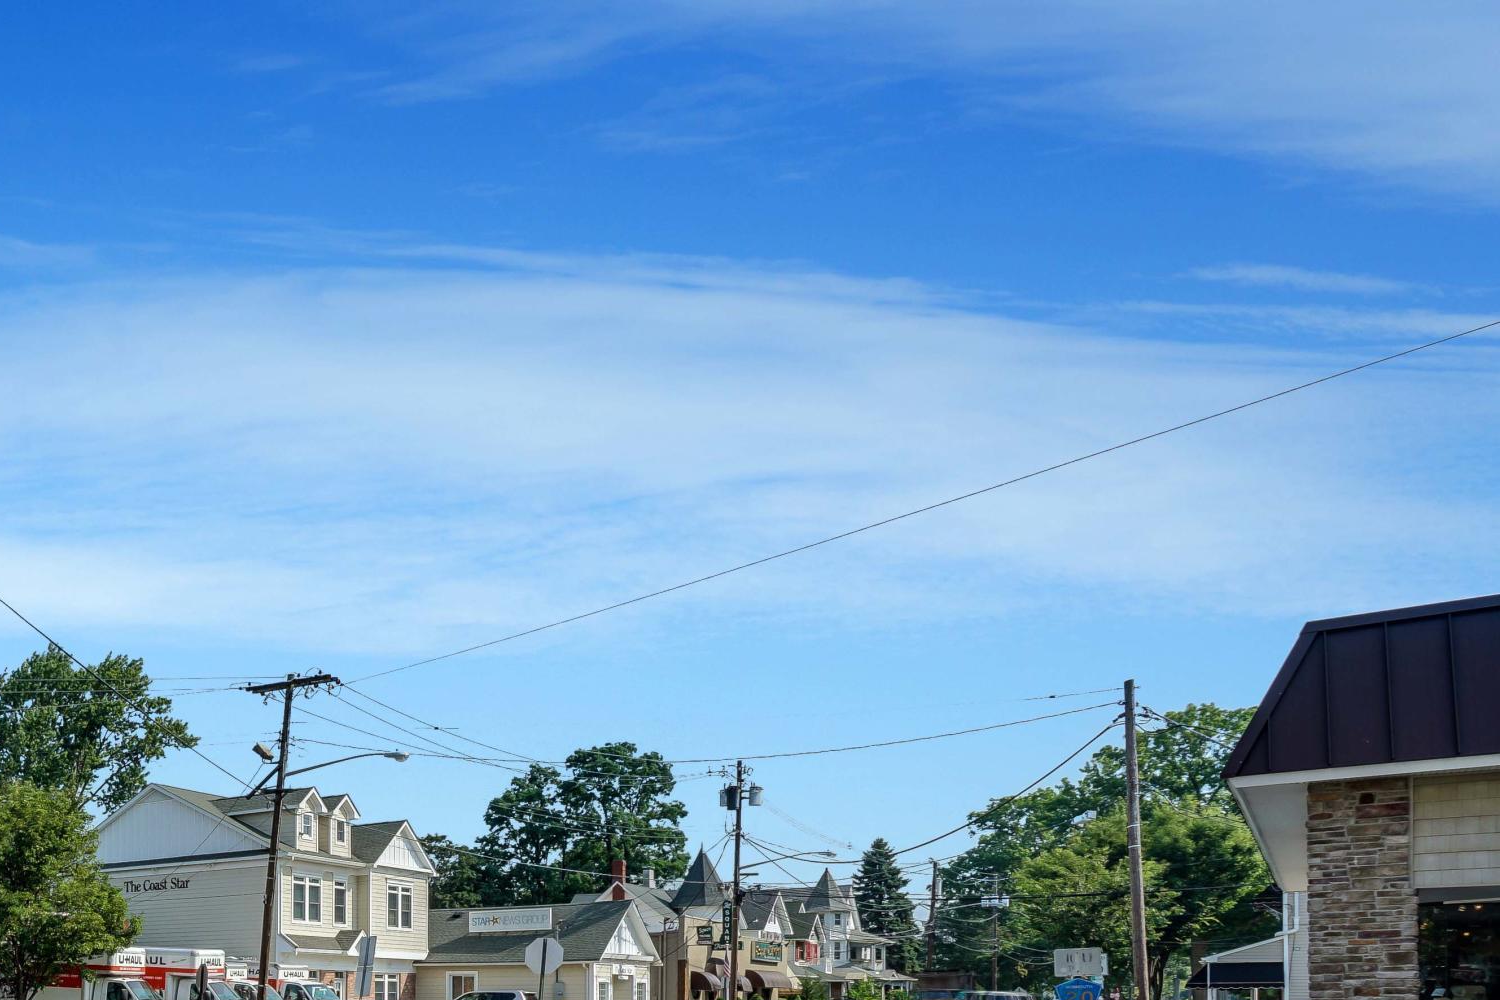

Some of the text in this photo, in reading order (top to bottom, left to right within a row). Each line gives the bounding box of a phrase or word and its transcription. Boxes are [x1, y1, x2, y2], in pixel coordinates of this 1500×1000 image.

[124, 876, 190, 893] The Coast Star
[471, 916, 491, 927] STAR
